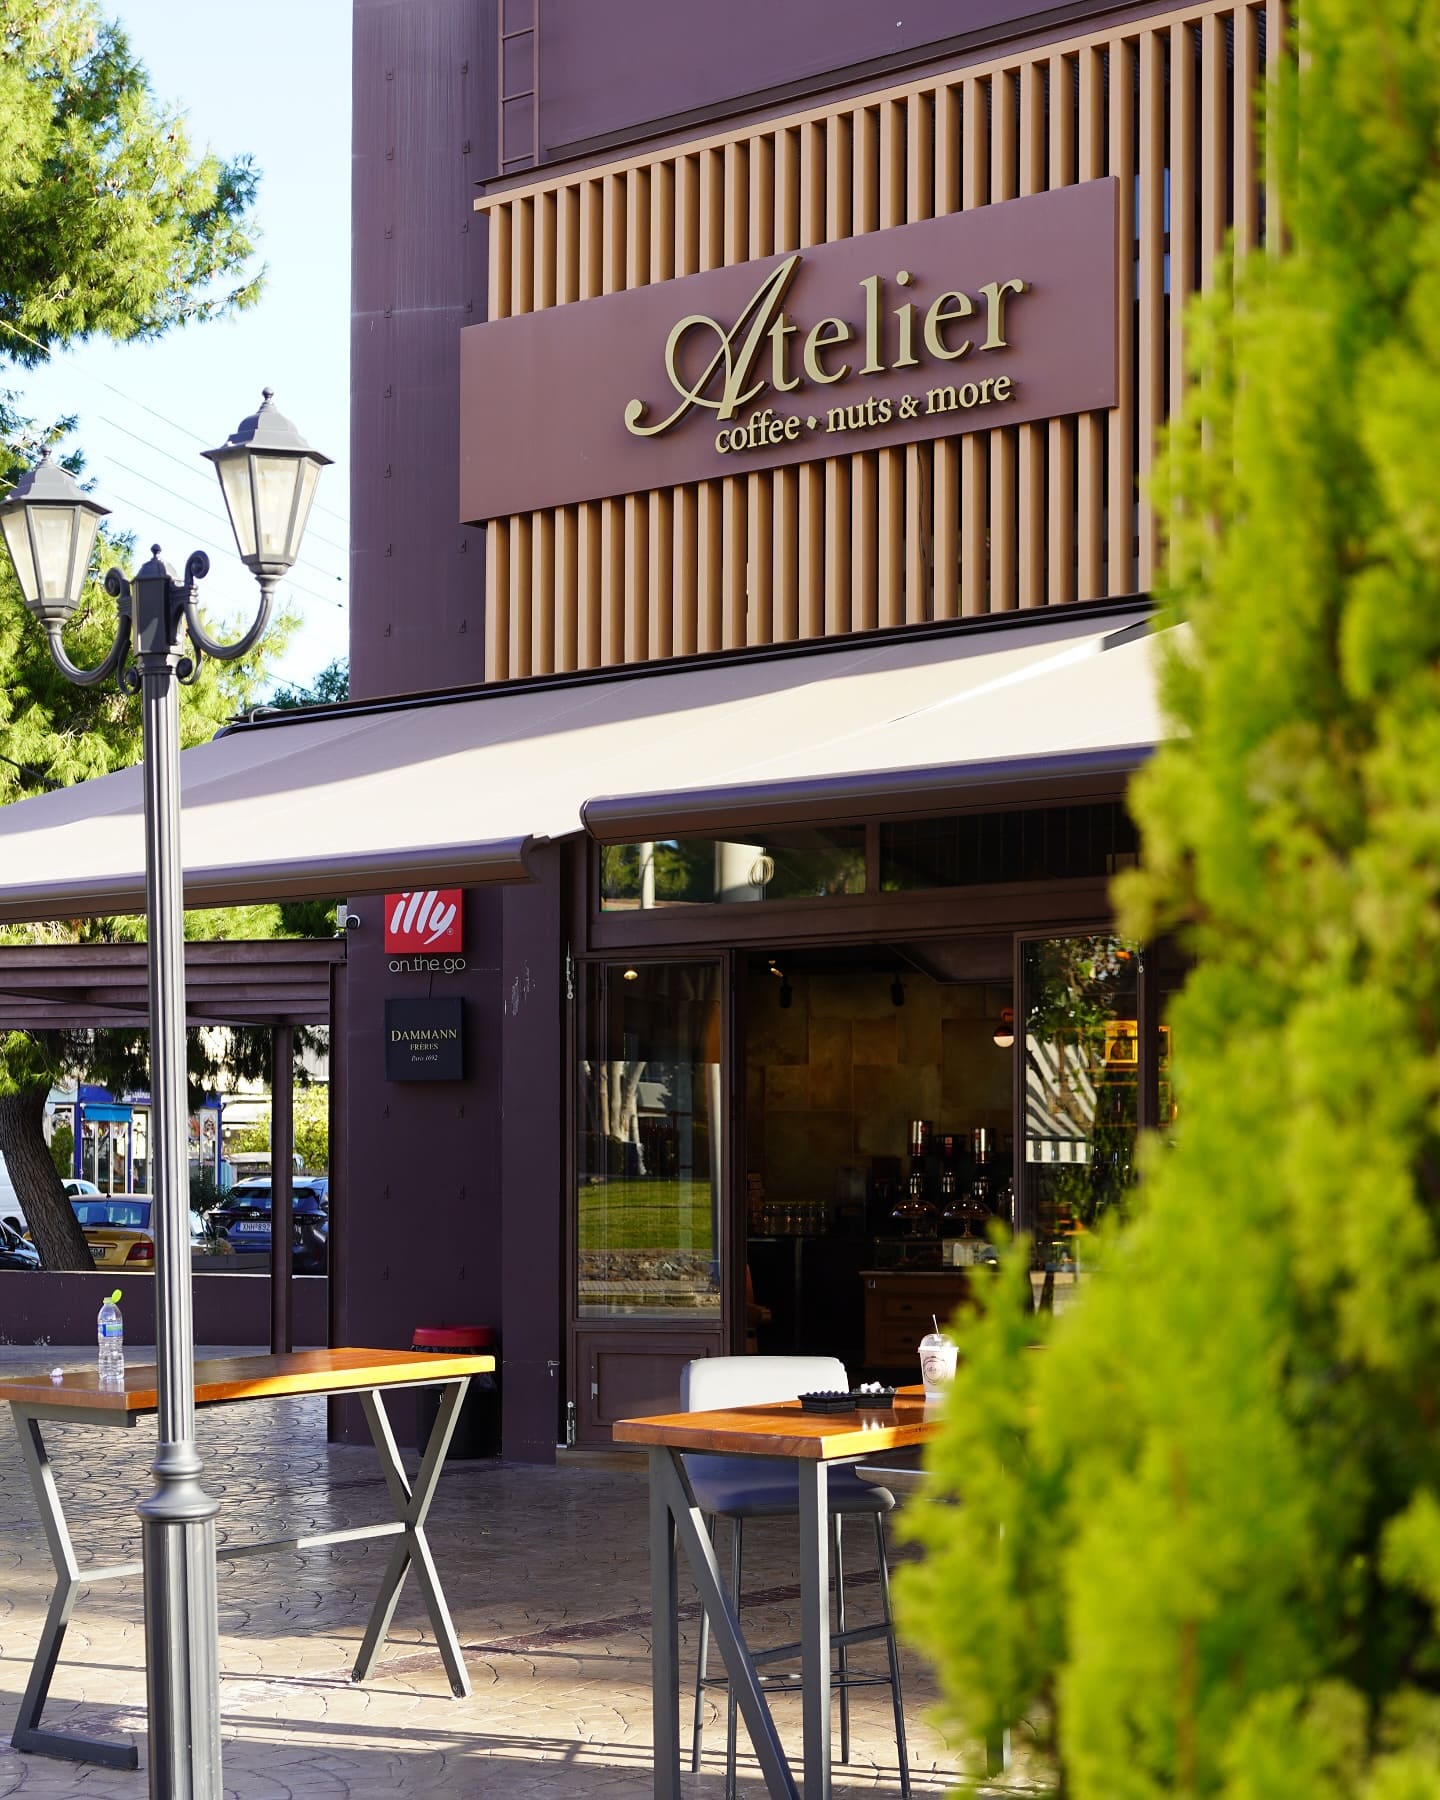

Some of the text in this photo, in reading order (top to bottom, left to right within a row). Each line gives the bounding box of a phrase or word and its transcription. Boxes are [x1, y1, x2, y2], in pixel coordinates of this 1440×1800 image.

[624, 255, 1029, 436] Atelier
[714, 375, 1013, 453] coffee nuts & more
[390, 890, 457, 945] illy
[388, 954, 466, 974] on the go
[391, 1029, 457, 1042] DAMMANN
